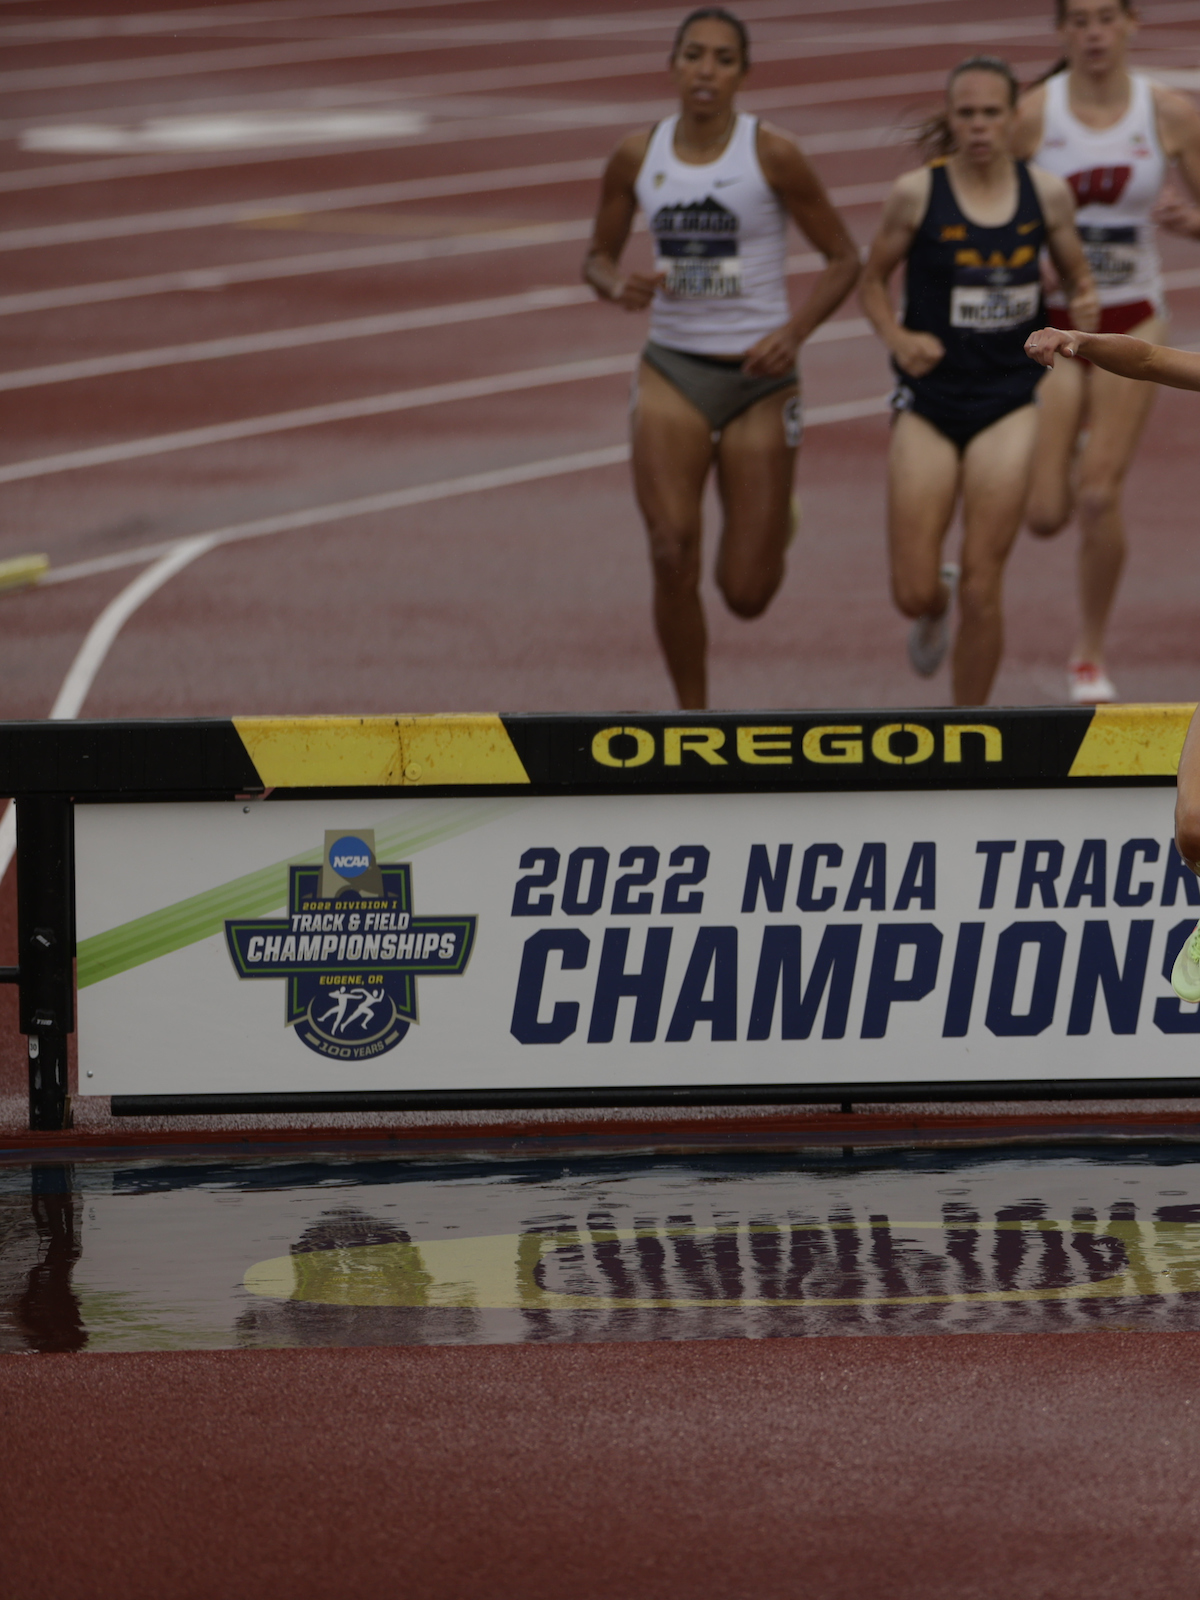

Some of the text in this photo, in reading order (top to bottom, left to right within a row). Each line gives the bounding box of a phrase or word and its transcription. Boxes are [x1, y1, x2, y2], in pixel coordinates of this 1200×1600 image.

[591, 723, 1002, 768] OREGON
[333, 855, 370, 868] NCAA
[511, 845, 710, 916] 2022
[741, 841, 936, 912] NCAA
[302, 901, 332, 911] 2022
[335, 900, 388, 910] DIVISION
[291, 912, 410, 932] TRACK & FIELD
[247, 932, 457, 962] CHAMPIONSHIPS
[319, 974, 384, 986] EUGENE, OR
[319, 1040, 385, 1058] 100 YEARS
